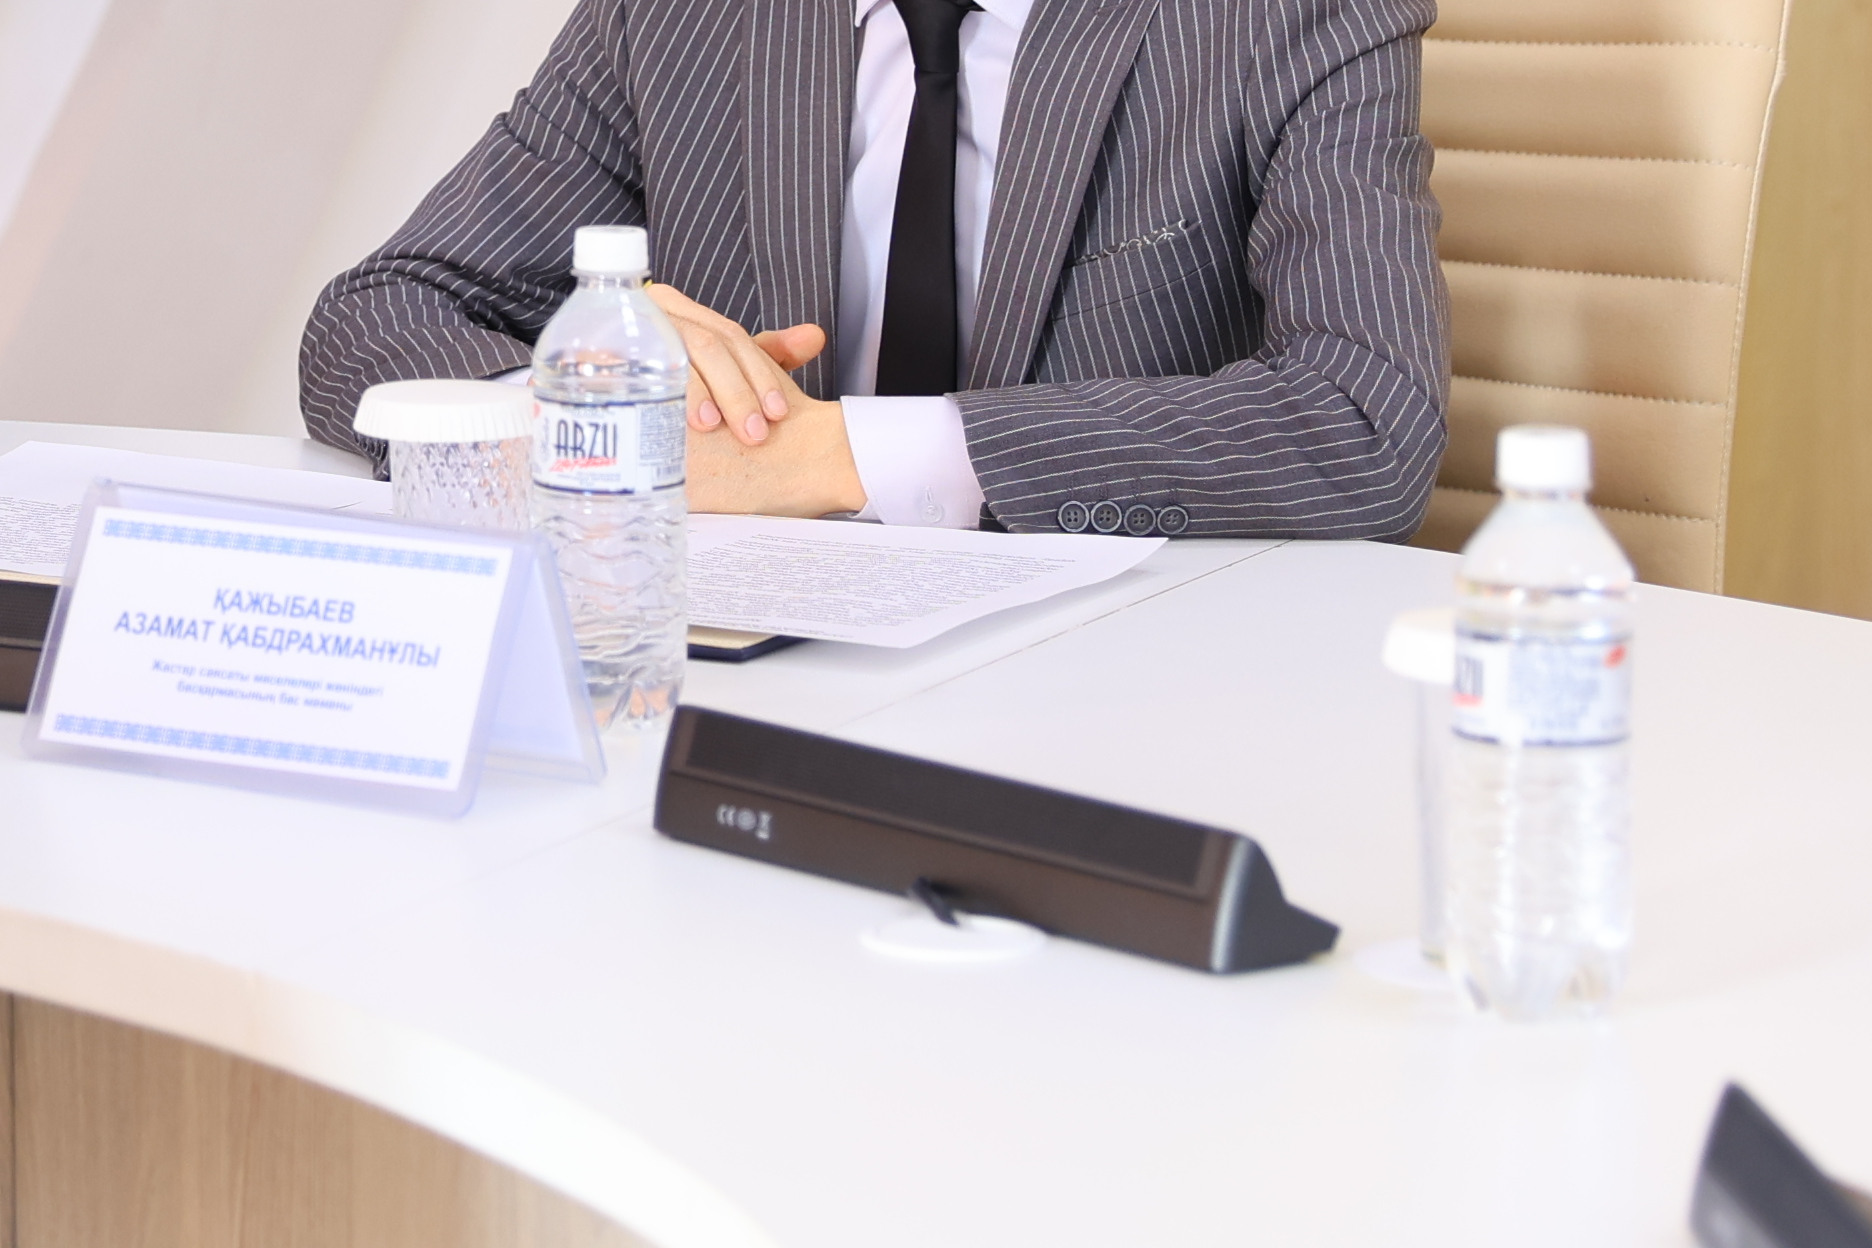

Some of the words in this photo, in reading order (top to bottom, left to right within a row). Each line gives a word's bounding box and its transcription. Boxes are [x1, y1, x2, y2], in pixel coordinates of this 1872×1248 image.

[554, 419, 617, 459] ARZU
[213, 587, 357, 625] ҚАЖЫБАЕВ
[114, 610, 216, 643] АЗАМАТ
[219, 622, 442, 669] ҚАБДРАХМАНҰЛЫ
